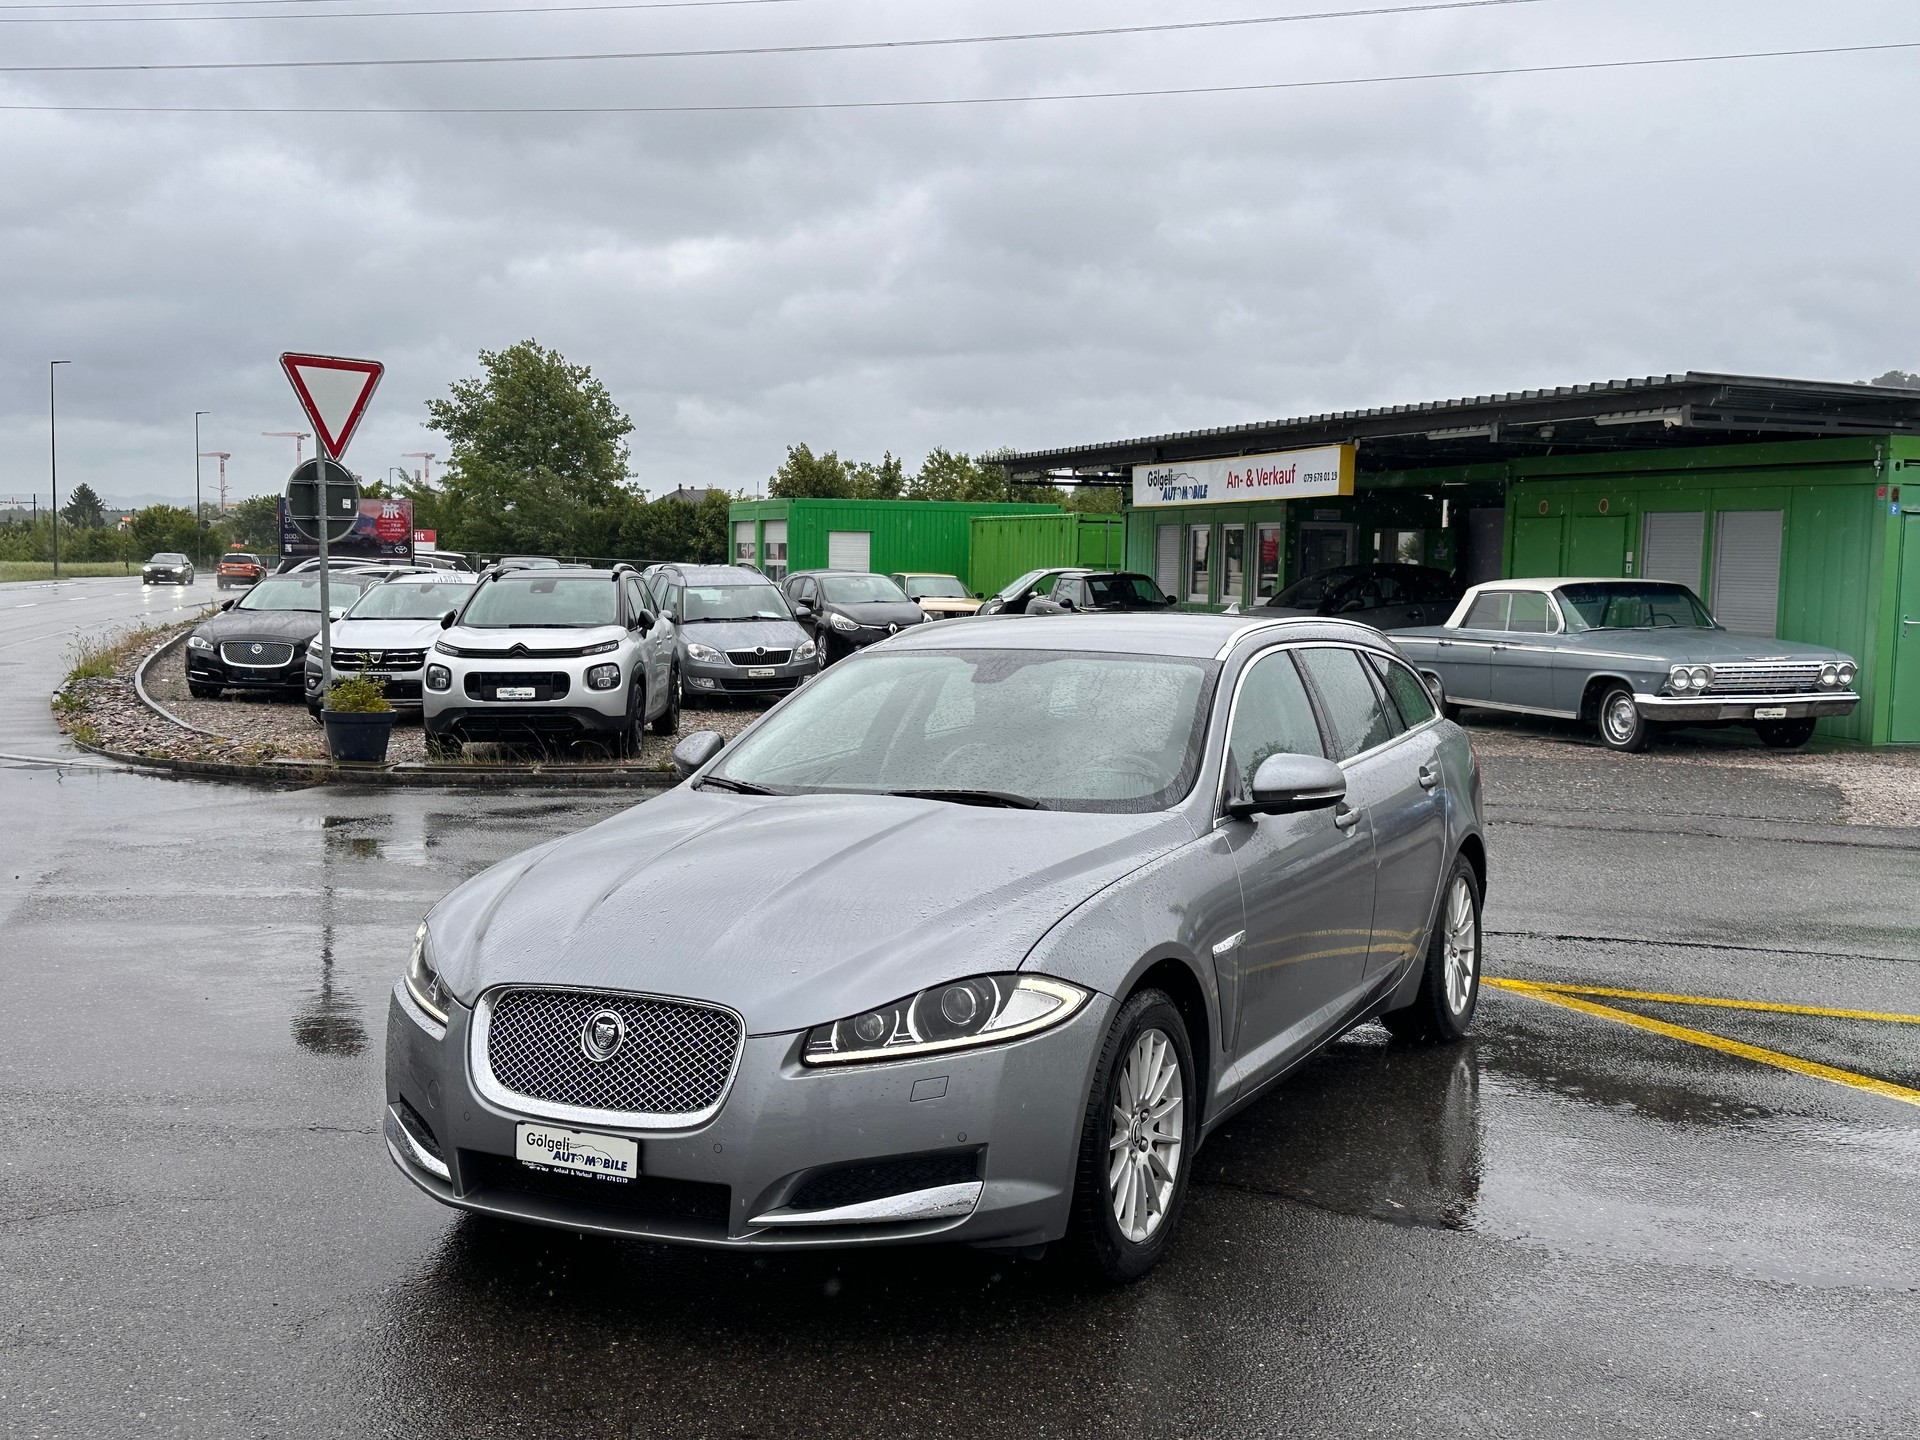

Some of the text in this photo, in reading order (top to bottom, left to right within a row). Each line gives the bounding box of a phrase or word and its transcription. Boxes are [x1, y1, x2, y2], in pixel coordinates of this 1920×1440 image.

[1147, 468, 1173, 491] Gölgeli
[1227, 471, 1243, 489] An-
[1246, 468, 1254, 488] &
[1256, 463, 1296, 487] Verkauf
[1303, 473, 1313, 482] 079
[1324, 471, 1330, 481] 01
[526, 1132, 570, 1153] Gölgeli
